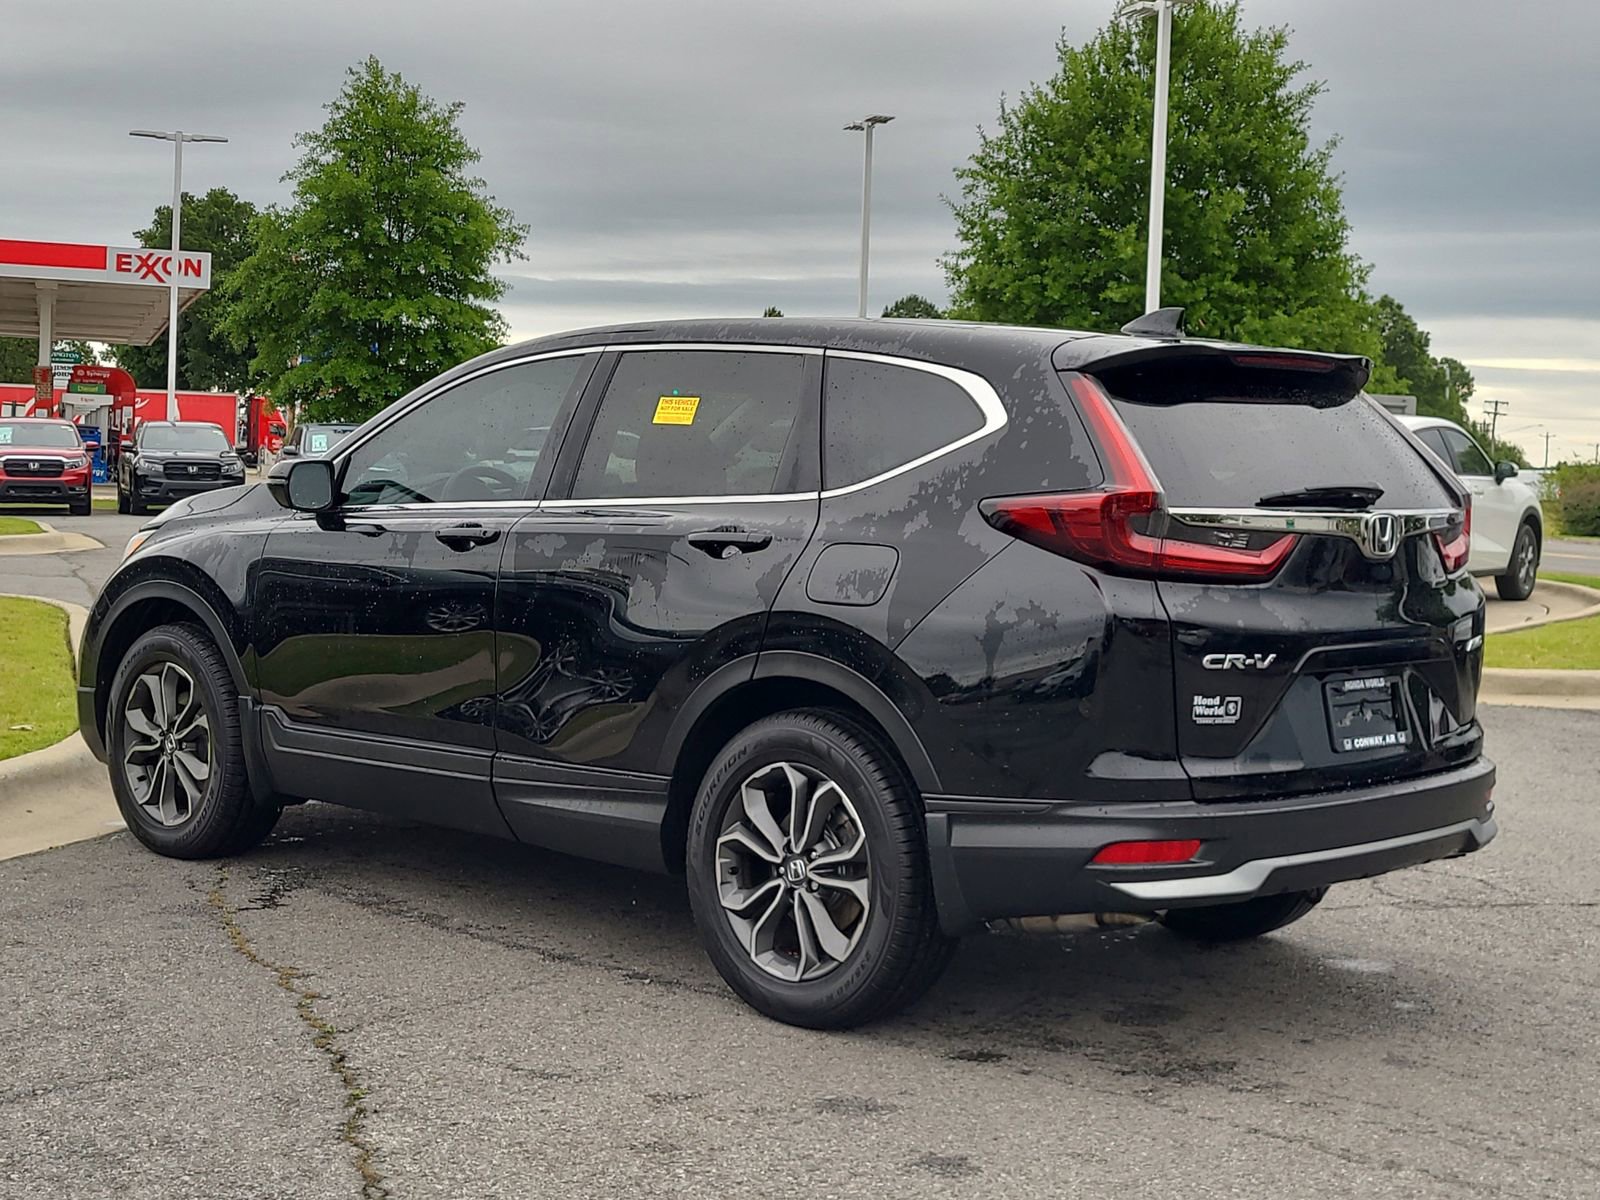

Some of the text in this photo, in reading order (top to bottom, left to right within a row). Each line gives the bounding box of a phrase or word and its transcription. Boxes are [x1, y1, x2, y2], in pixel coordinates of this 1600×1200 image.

[115, 252, 202, 283] EXXON
[86, 369, 111, 378] Synergy
[1202, 653, 1277, 670] CR-V
[1194, 705, 1224, 716] World
[1385, 733, 1397, 744] AR
[694, 745, 748, 836] SCORPION
